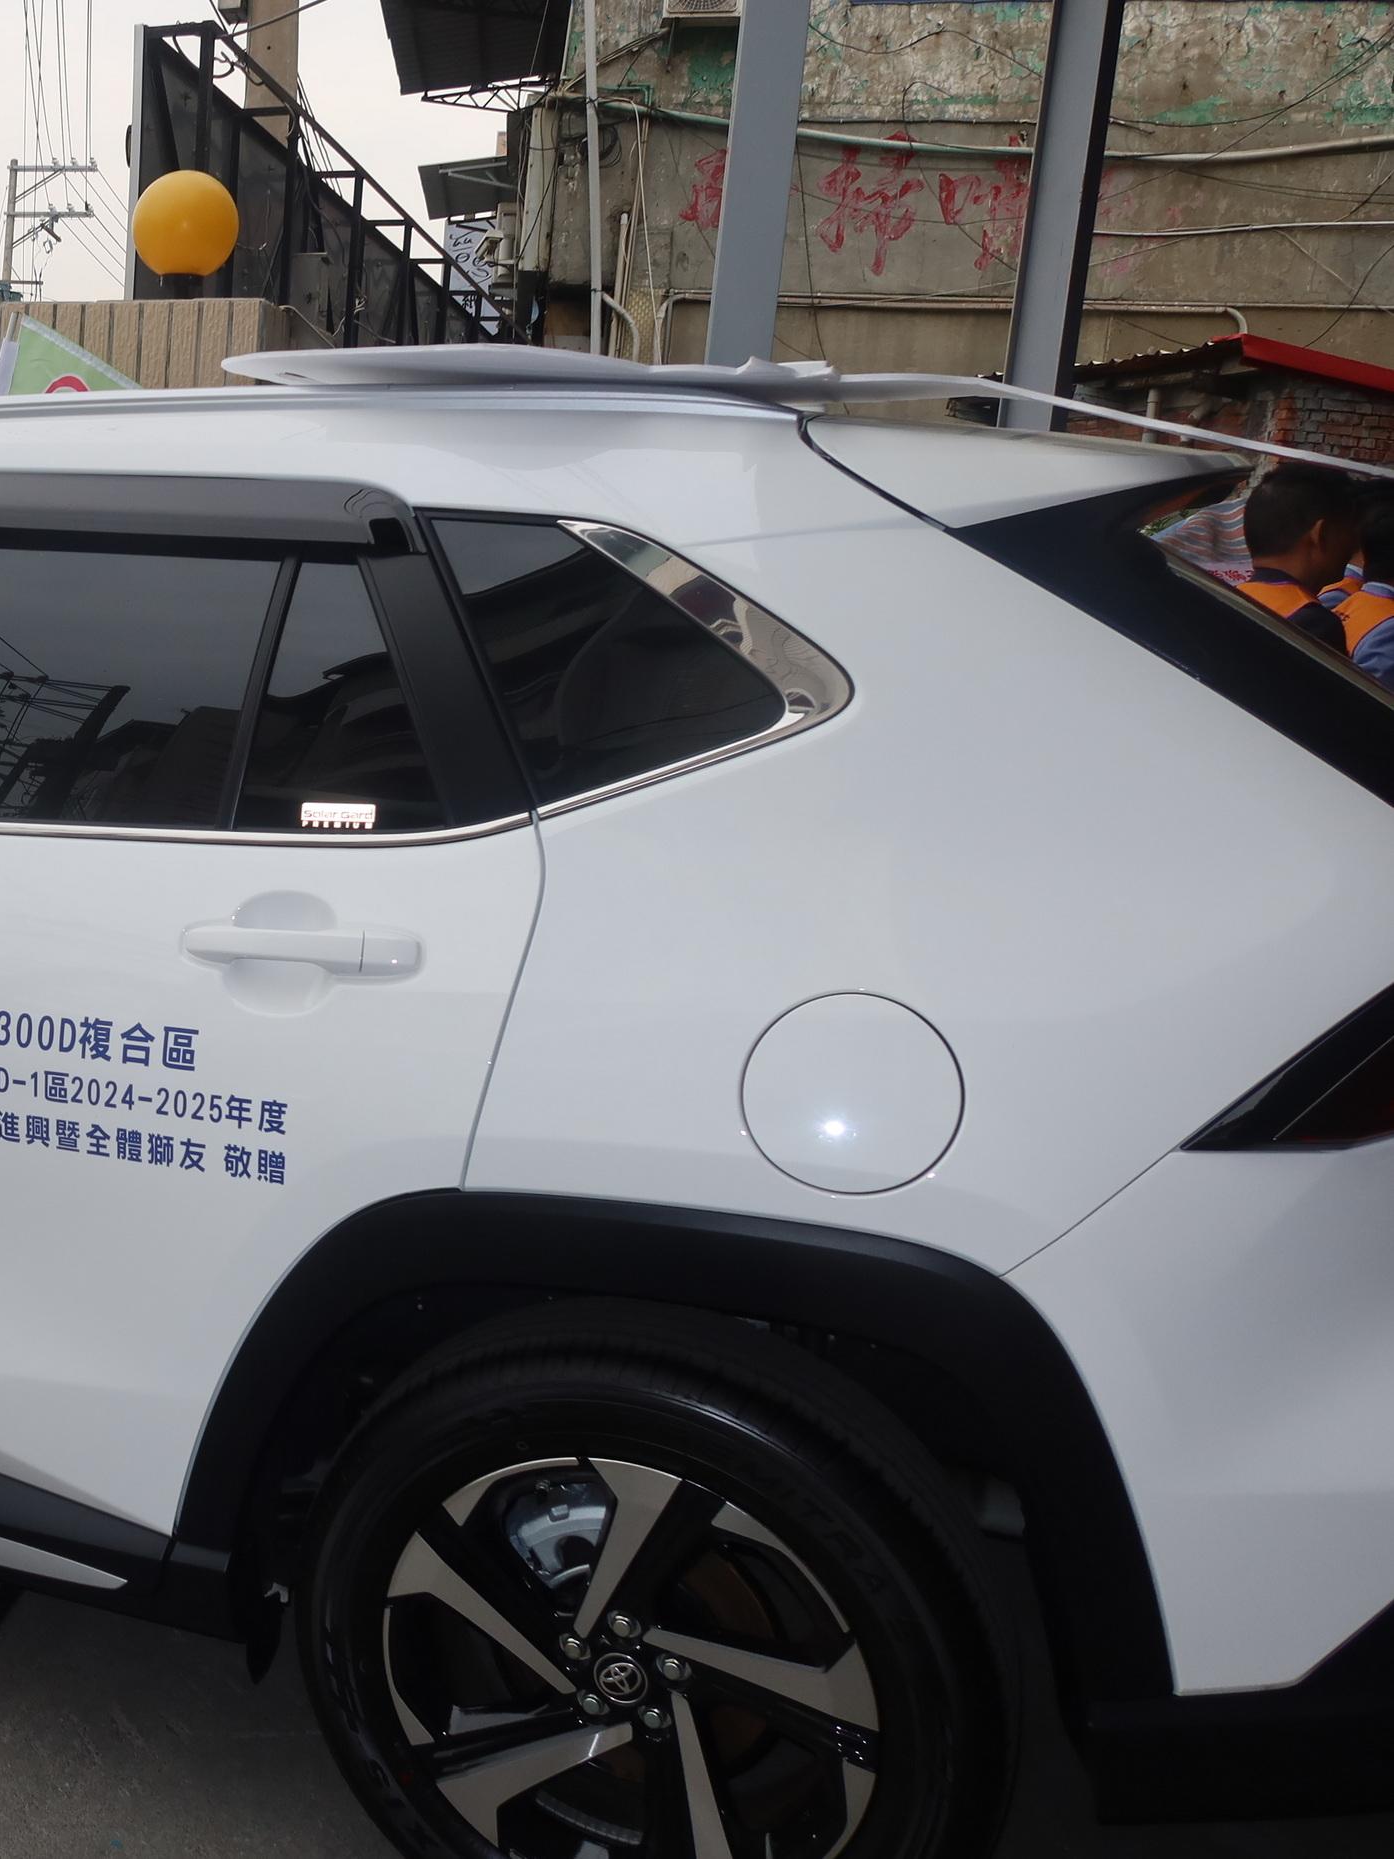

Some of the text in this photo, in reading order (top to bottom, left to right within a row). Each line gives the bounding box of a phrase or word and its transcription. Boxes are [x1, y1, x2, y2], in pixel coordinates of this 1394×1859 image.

[303, 809, 374, 820] Solar Gard
[302, 820, 374, 829] PREMIUM
[223, 1143, 286, 1185] 敬贈
